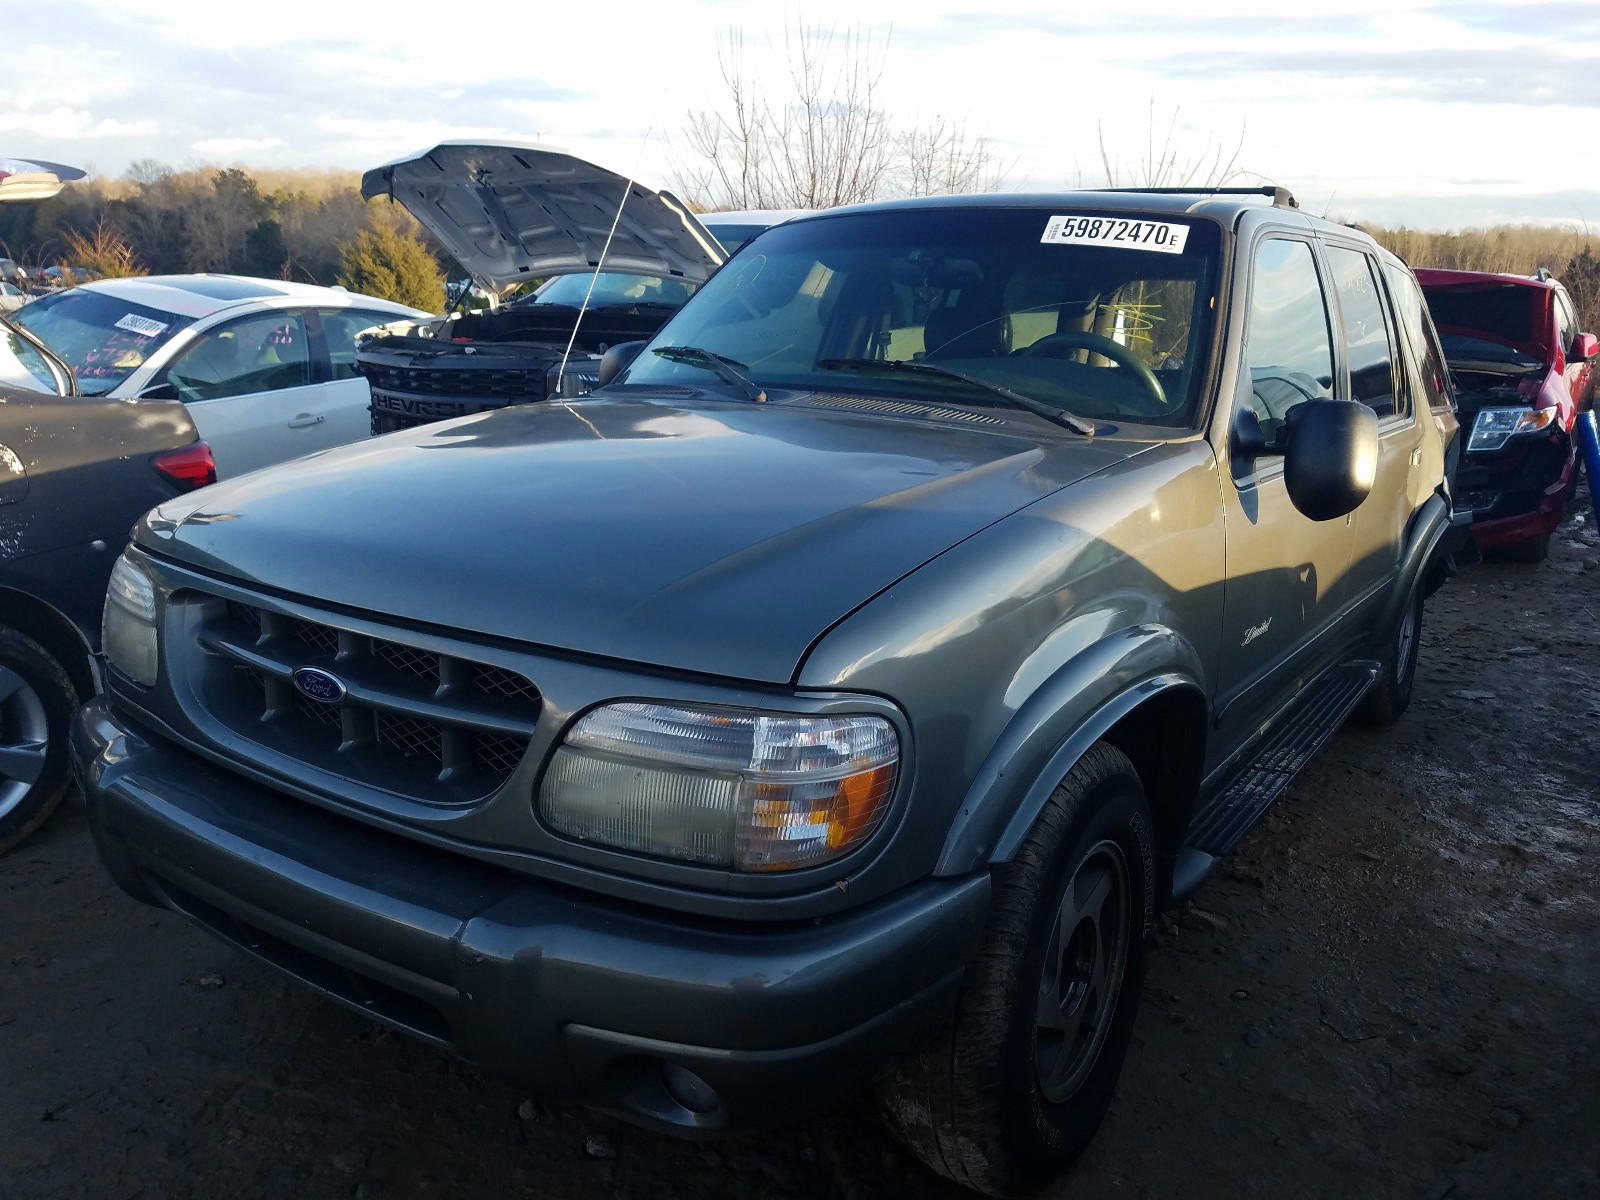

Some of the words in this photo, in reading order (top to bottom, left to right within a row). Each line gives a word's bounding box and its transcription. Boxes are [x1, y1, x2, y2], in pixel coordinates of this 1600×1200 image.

[1061, 218, 1170, 245] 59872470
[1169, 234, 1179, 246] E
[304, 673, 332, 697] Ford
